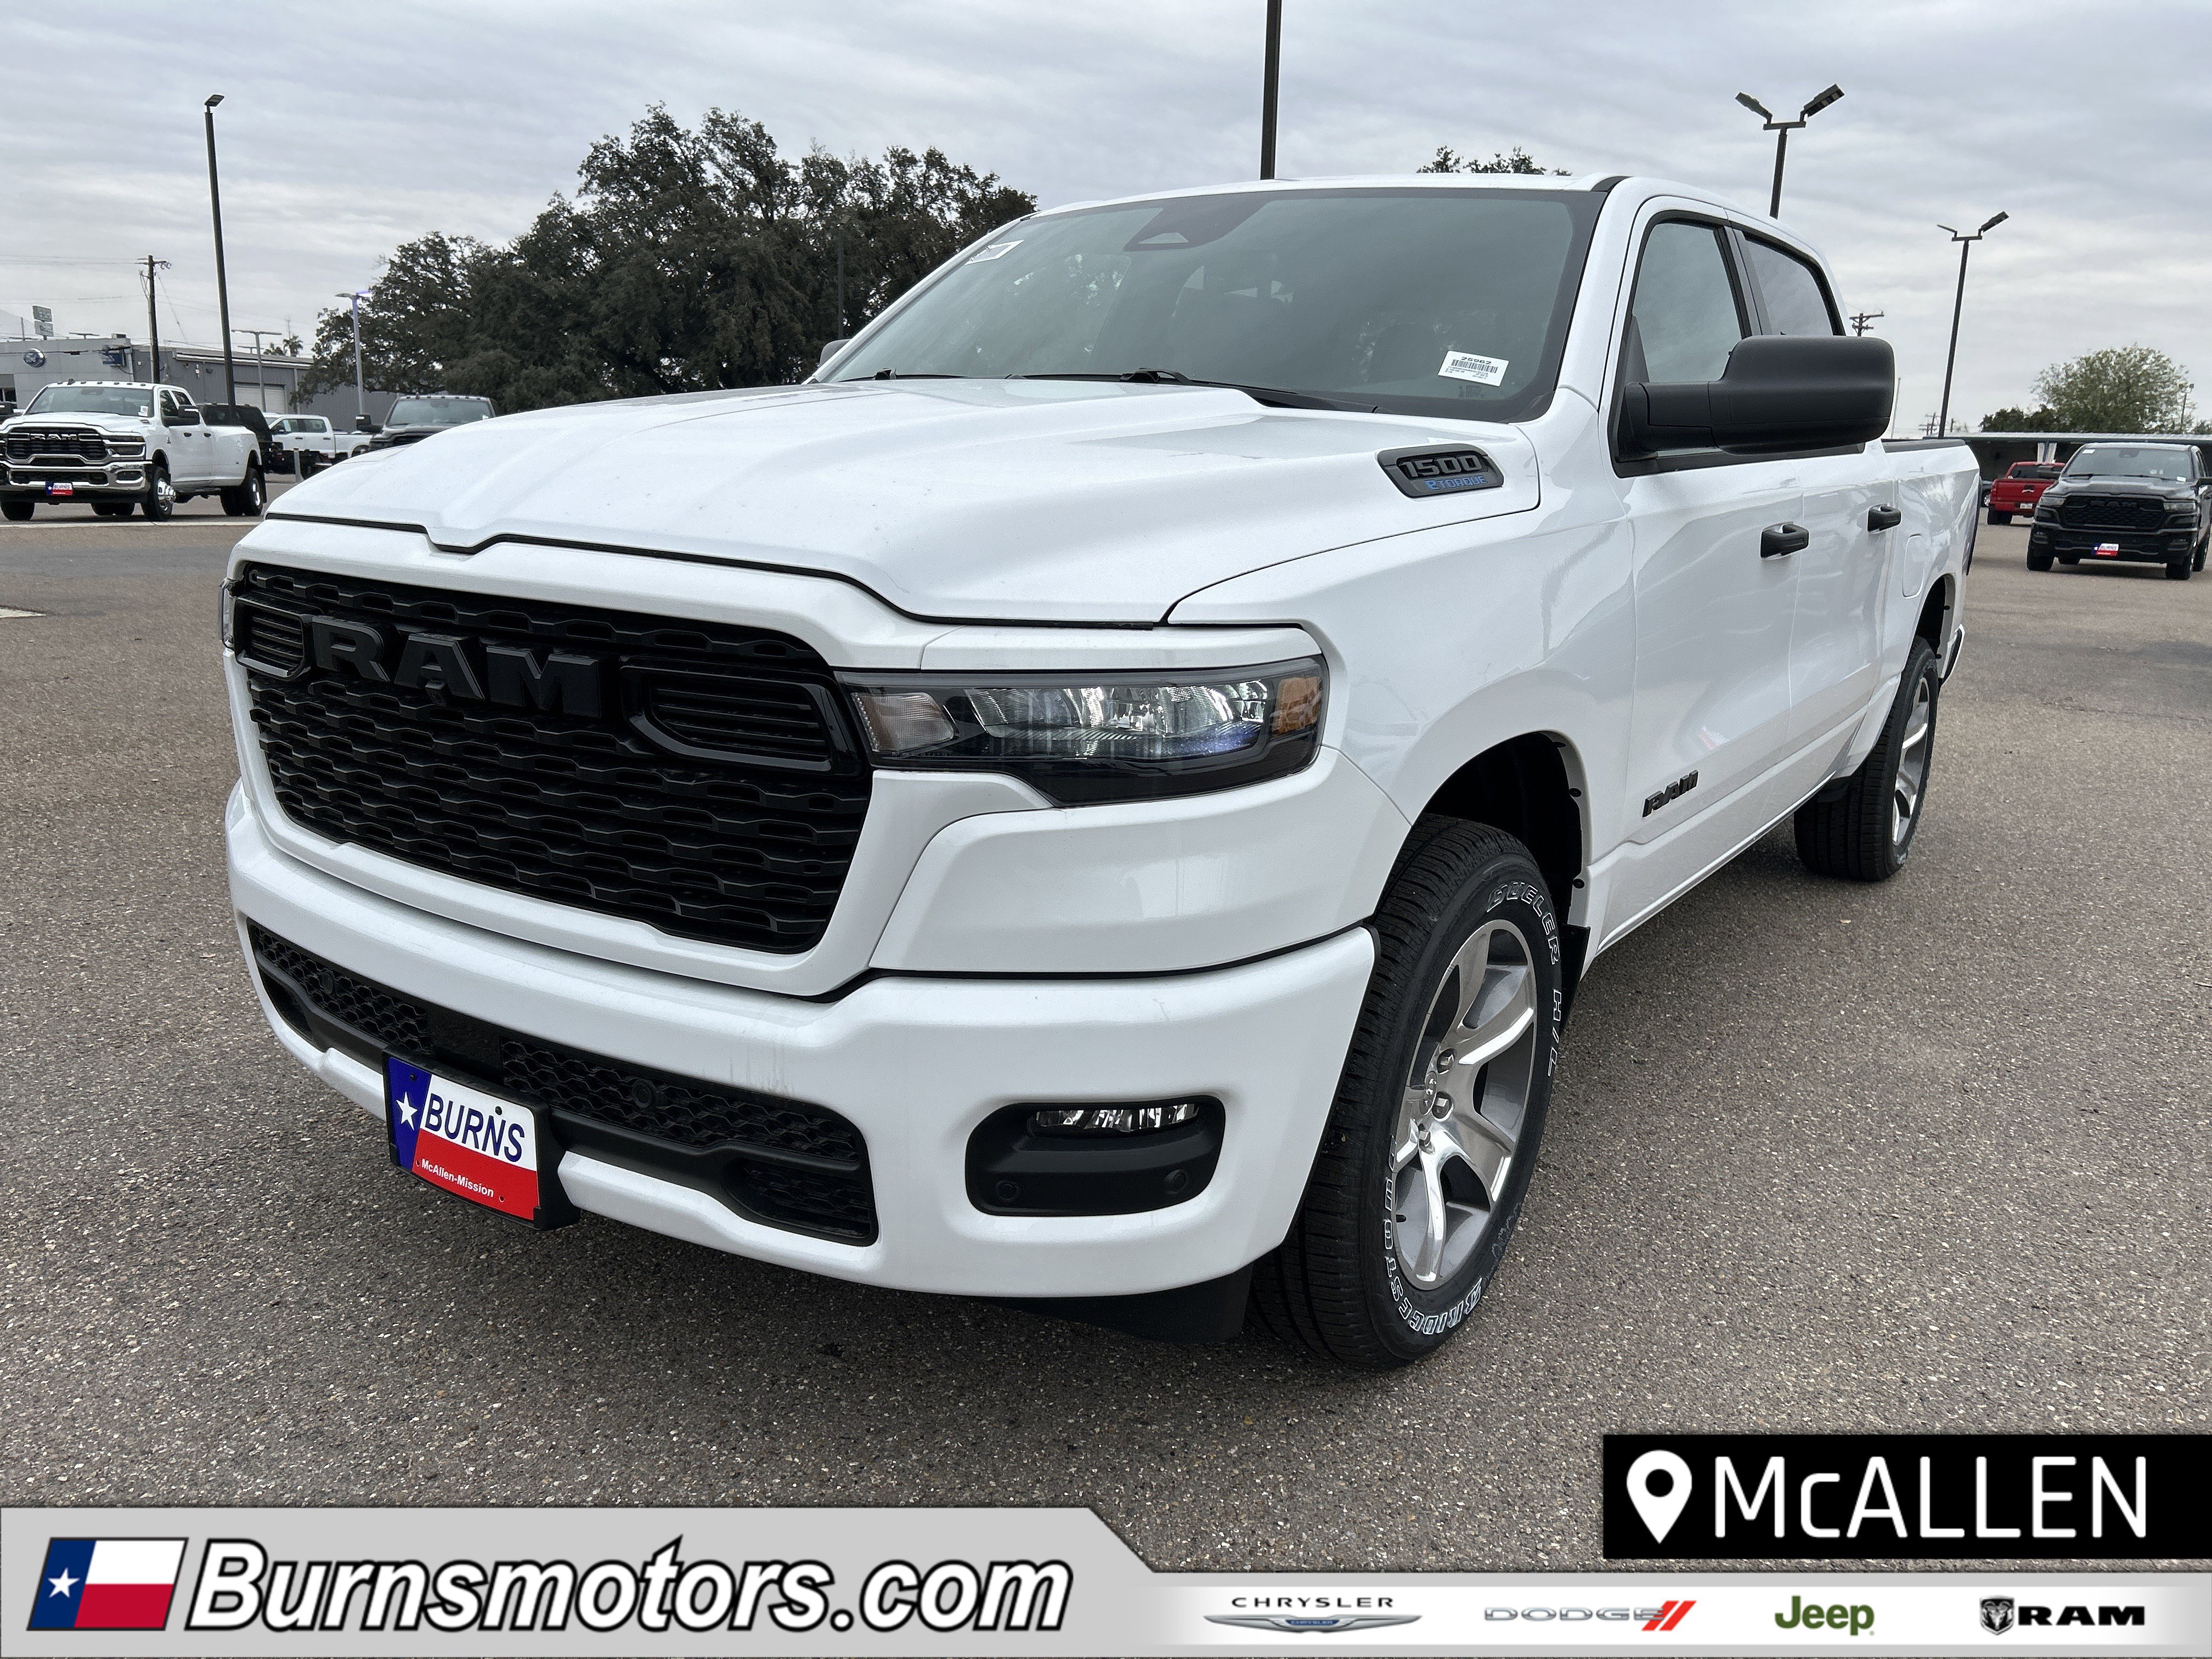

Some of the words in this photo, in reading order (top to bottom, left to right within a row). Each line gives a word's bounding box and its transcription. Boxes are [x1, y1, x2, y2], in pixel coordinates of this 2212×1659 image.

[1400, 455, 1482, 477] 1500
[1424, 475, 1487, 490] eTORQUE
[312, 613, 602, 718] RAM
[1642, 770, 1699, 817] RAM
[1486, 882, 1560, 965] DUELER
[1548, 989, 1562, 1077] H/L
[425, 1092, 526, 1163] BURNS
[421, 1158, 494, 1198] McAllen-Mission
